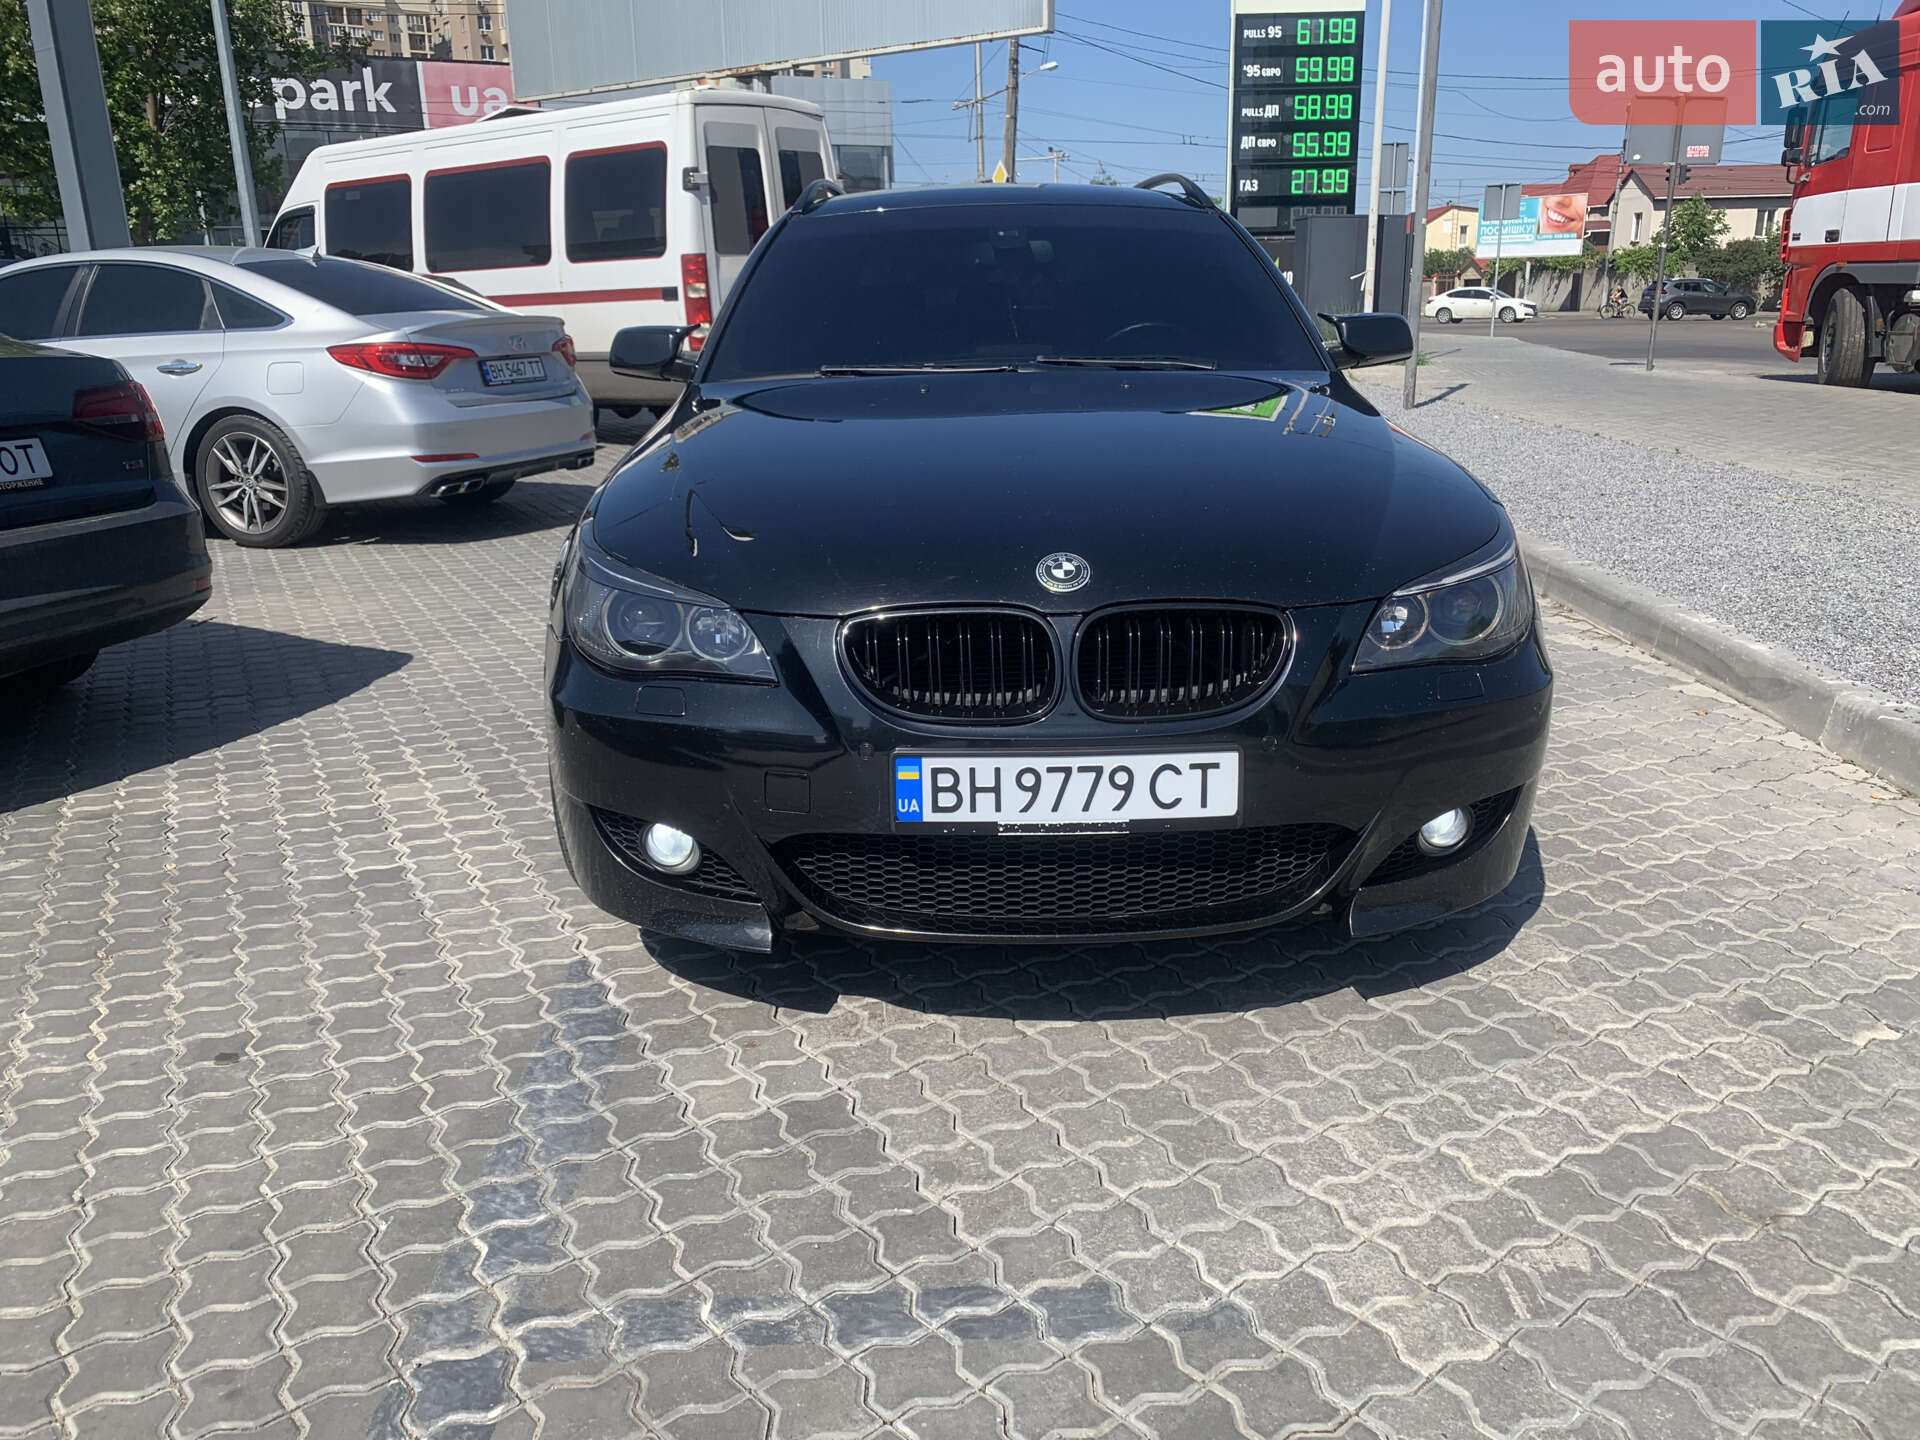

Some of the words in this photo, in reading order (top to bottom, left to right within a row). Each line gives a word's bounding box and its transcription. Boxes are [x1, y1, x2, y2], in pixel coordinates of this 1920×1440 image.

[1244, 29, 1266, 38] PULLS
[1267, 25, 1282, 38] 95
[1297, 18, 1356, 45] 61.99
[1295, 57, 1354, 83] 59.99
[451, 85, 508, 116] ua
[1242, 107, 1264, 117] PULLS
[1264, 105, 1280, 118] ДП
[1294, 94, 1353, 120] 58.99
[1240, 136, 1256, 150] ДП
[1292, 131, 1350, 157] 55.99
[1239, 179, 1259, 192] ГАЗ
[1291, 169, 1349, 194] 27.99
[930, 766, 1001, 813] BH
[1015, 765, 1135, 813] 9779
[1149, 762, 1220, 810] CT
[898, 799, 920, 813] UA
